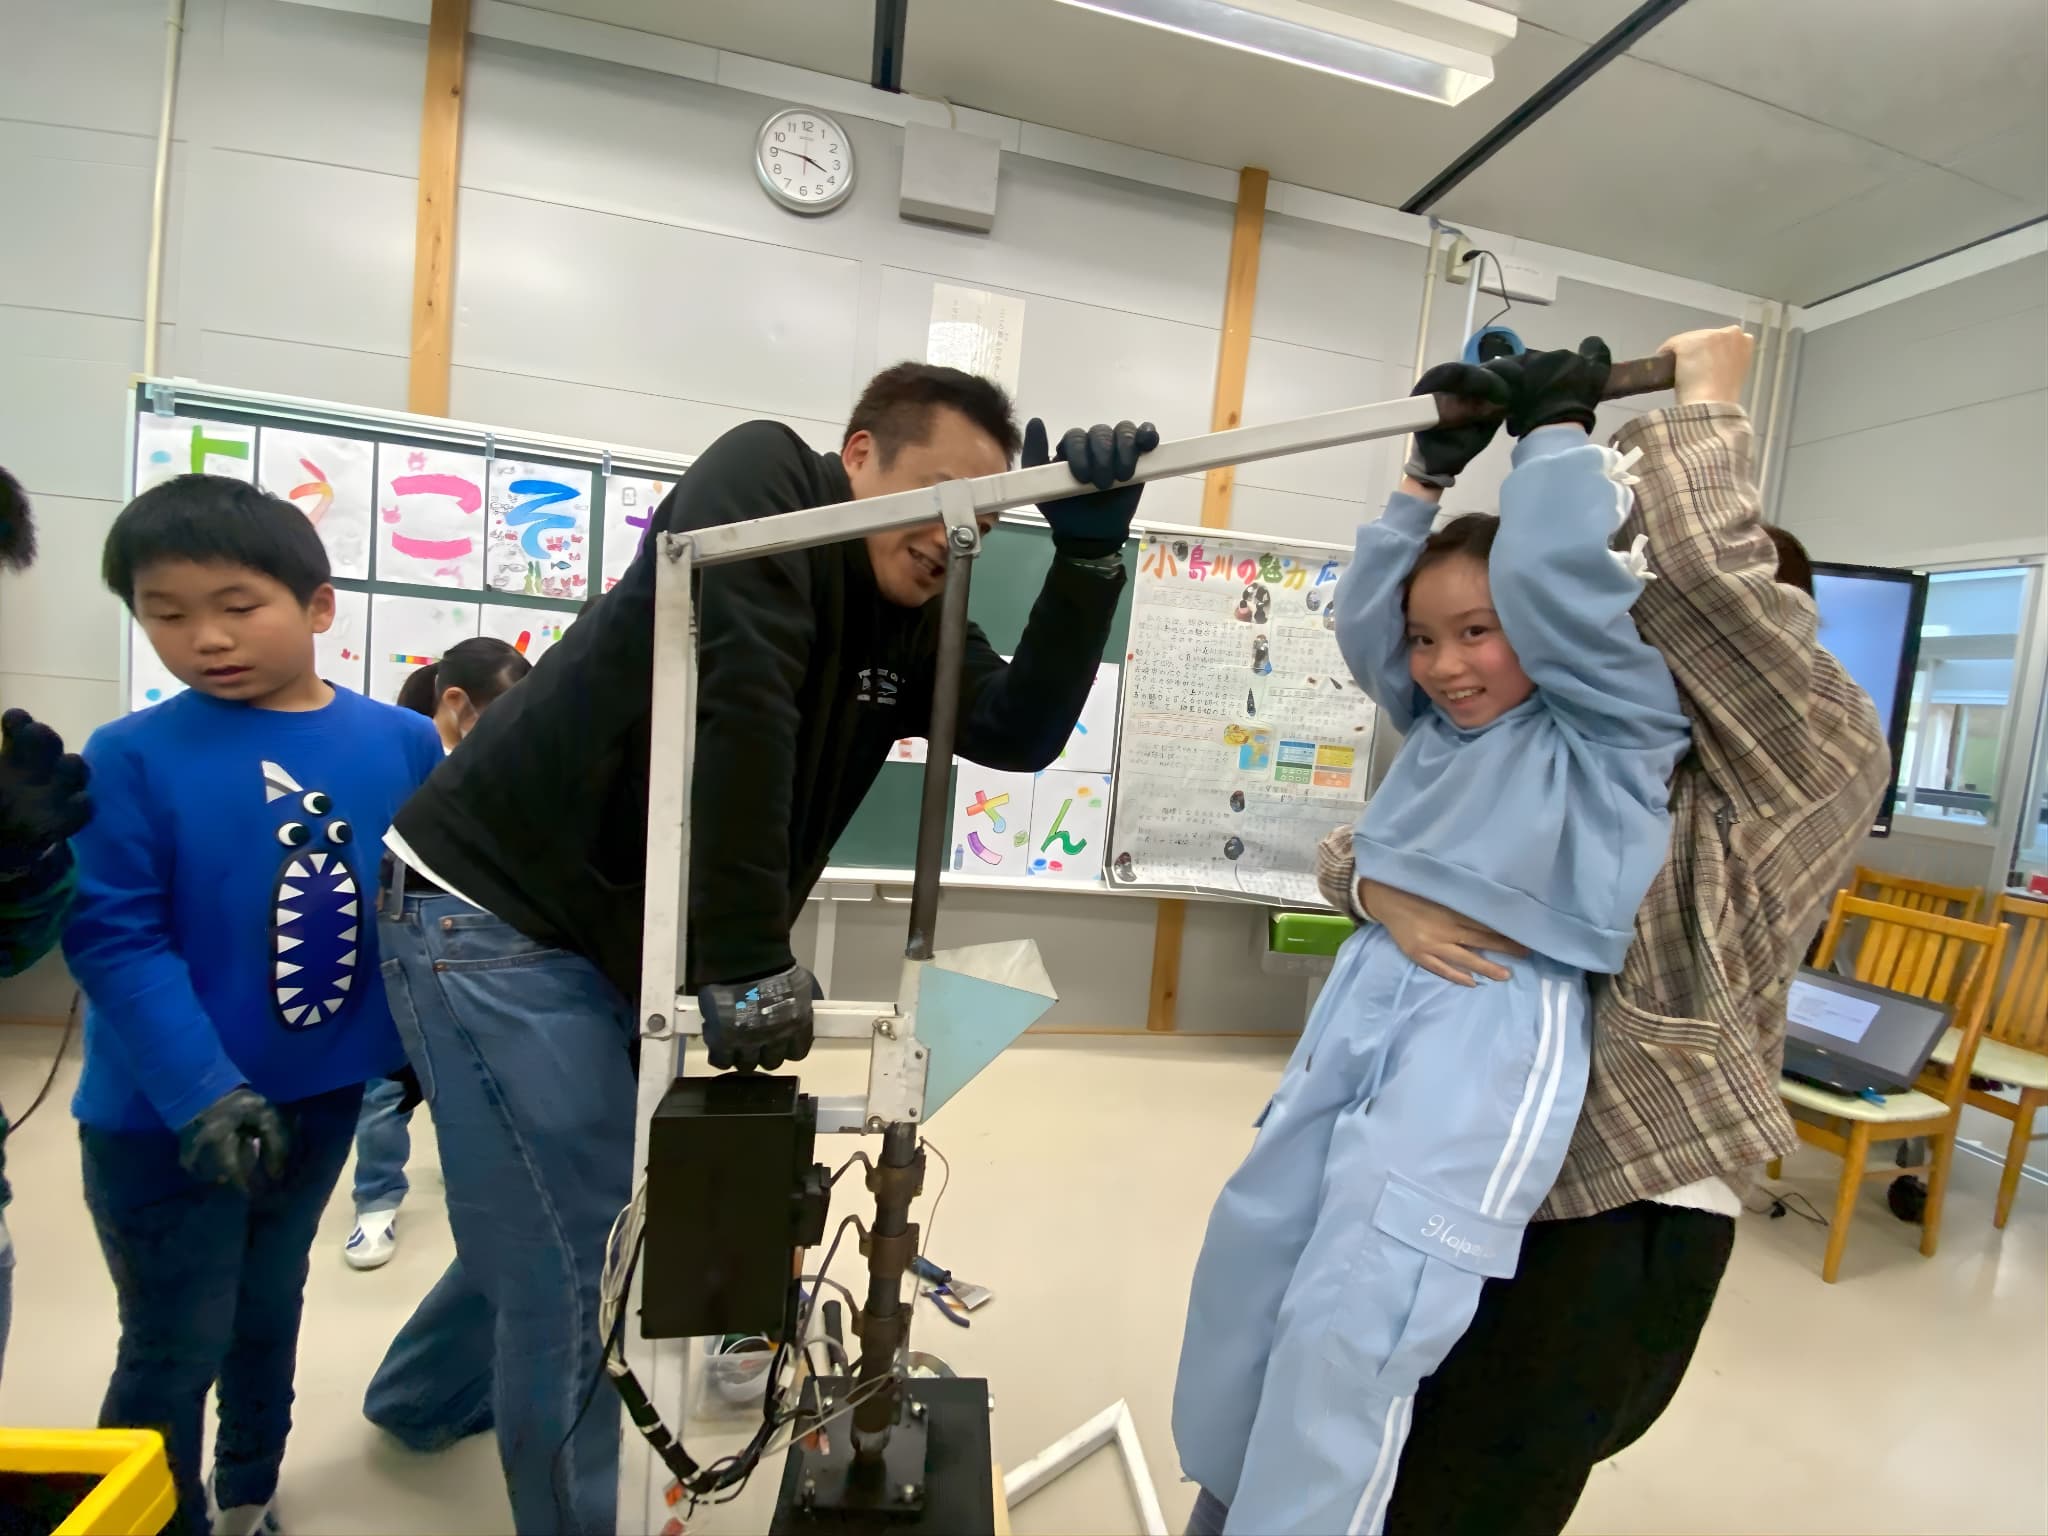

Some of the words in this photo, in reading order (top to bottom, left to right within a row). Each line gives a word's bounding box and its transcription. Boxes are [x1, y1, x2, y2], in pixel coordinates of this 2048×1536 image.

[787, 122, 797, 133] 11
[802, 121, 814, 132] 12
[774, 131, 786, 143] 10
[769, 146, 779, 158] 9
[829, 143, 838, 154] 2
[773, 163, 782, 175] 8
[832, 159, 841, 171] 3
[783, 177, 793, 189] 7
[826, 175, 836, 186] 4
[799, 185, 808, 197] 6
[815, 184, 825, 195] 5
